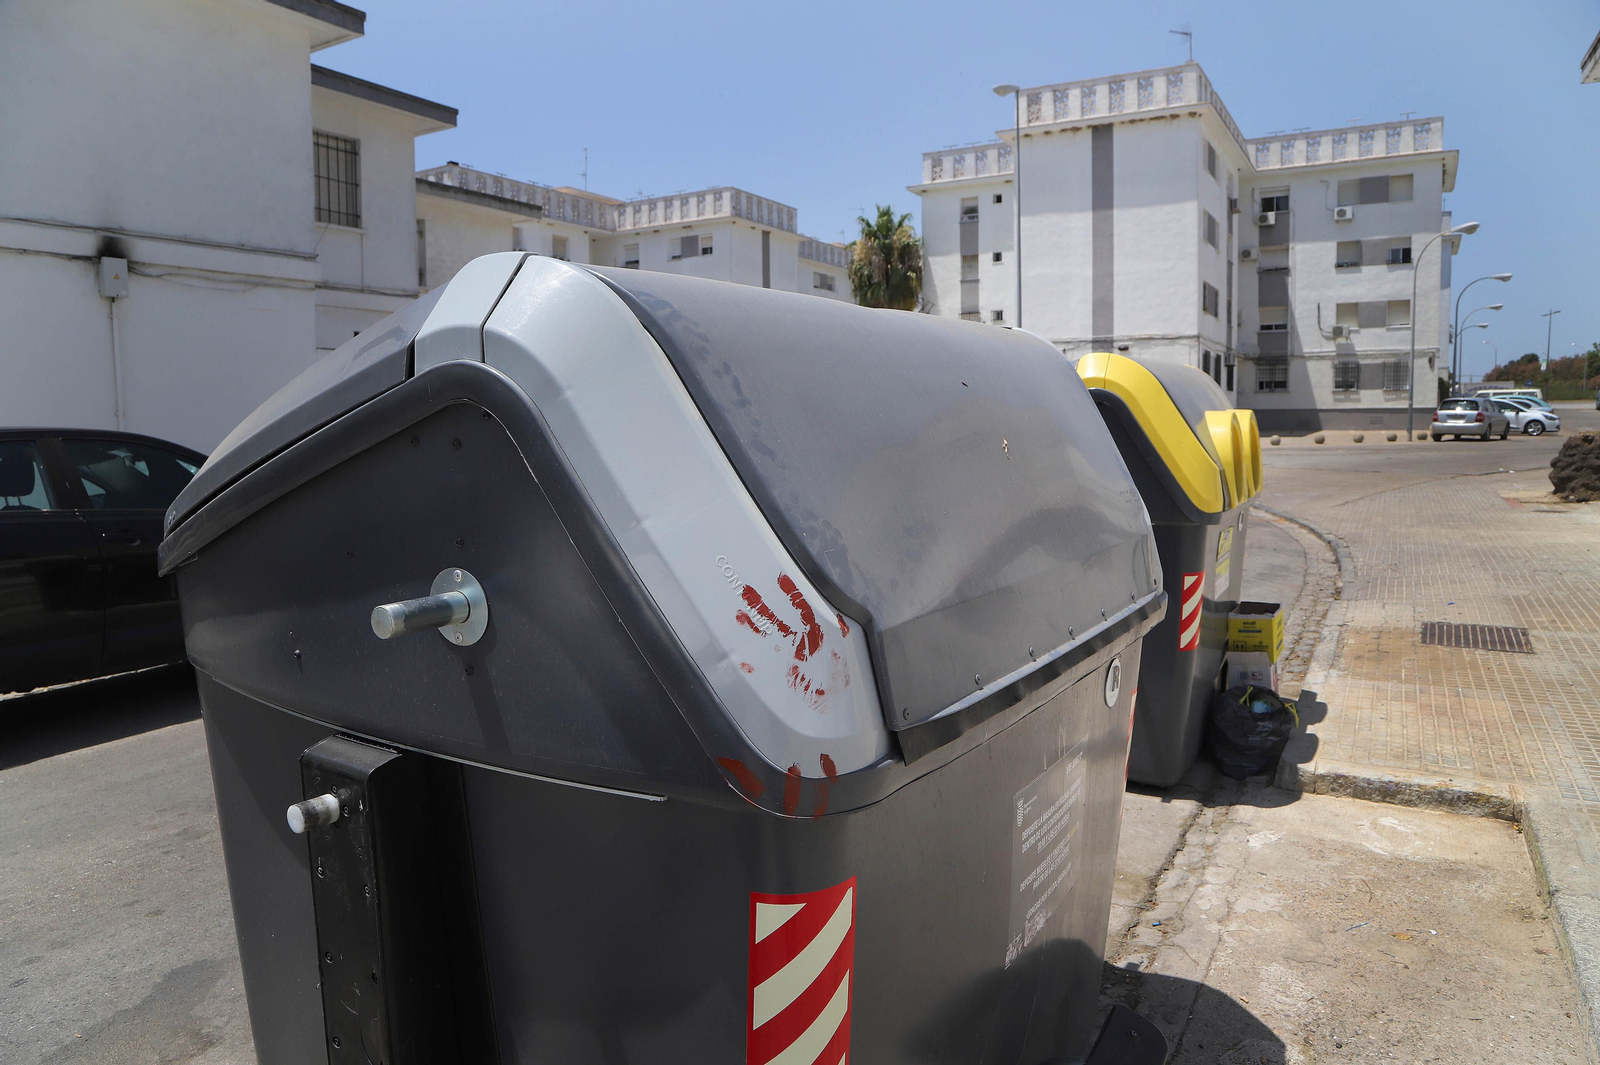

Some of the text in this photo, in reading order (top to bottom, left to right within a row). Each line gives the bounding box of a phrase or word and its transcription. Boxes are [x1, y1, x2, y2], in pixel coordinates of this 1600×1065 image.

[1021, 819, 1038, 841] DEPOSITE
[1021, 834, 1035, 853] DENTRO
[1020, 869, 1037, 892] DEPOSITE
[1036, 854, 1050, 875] MUEBLES
